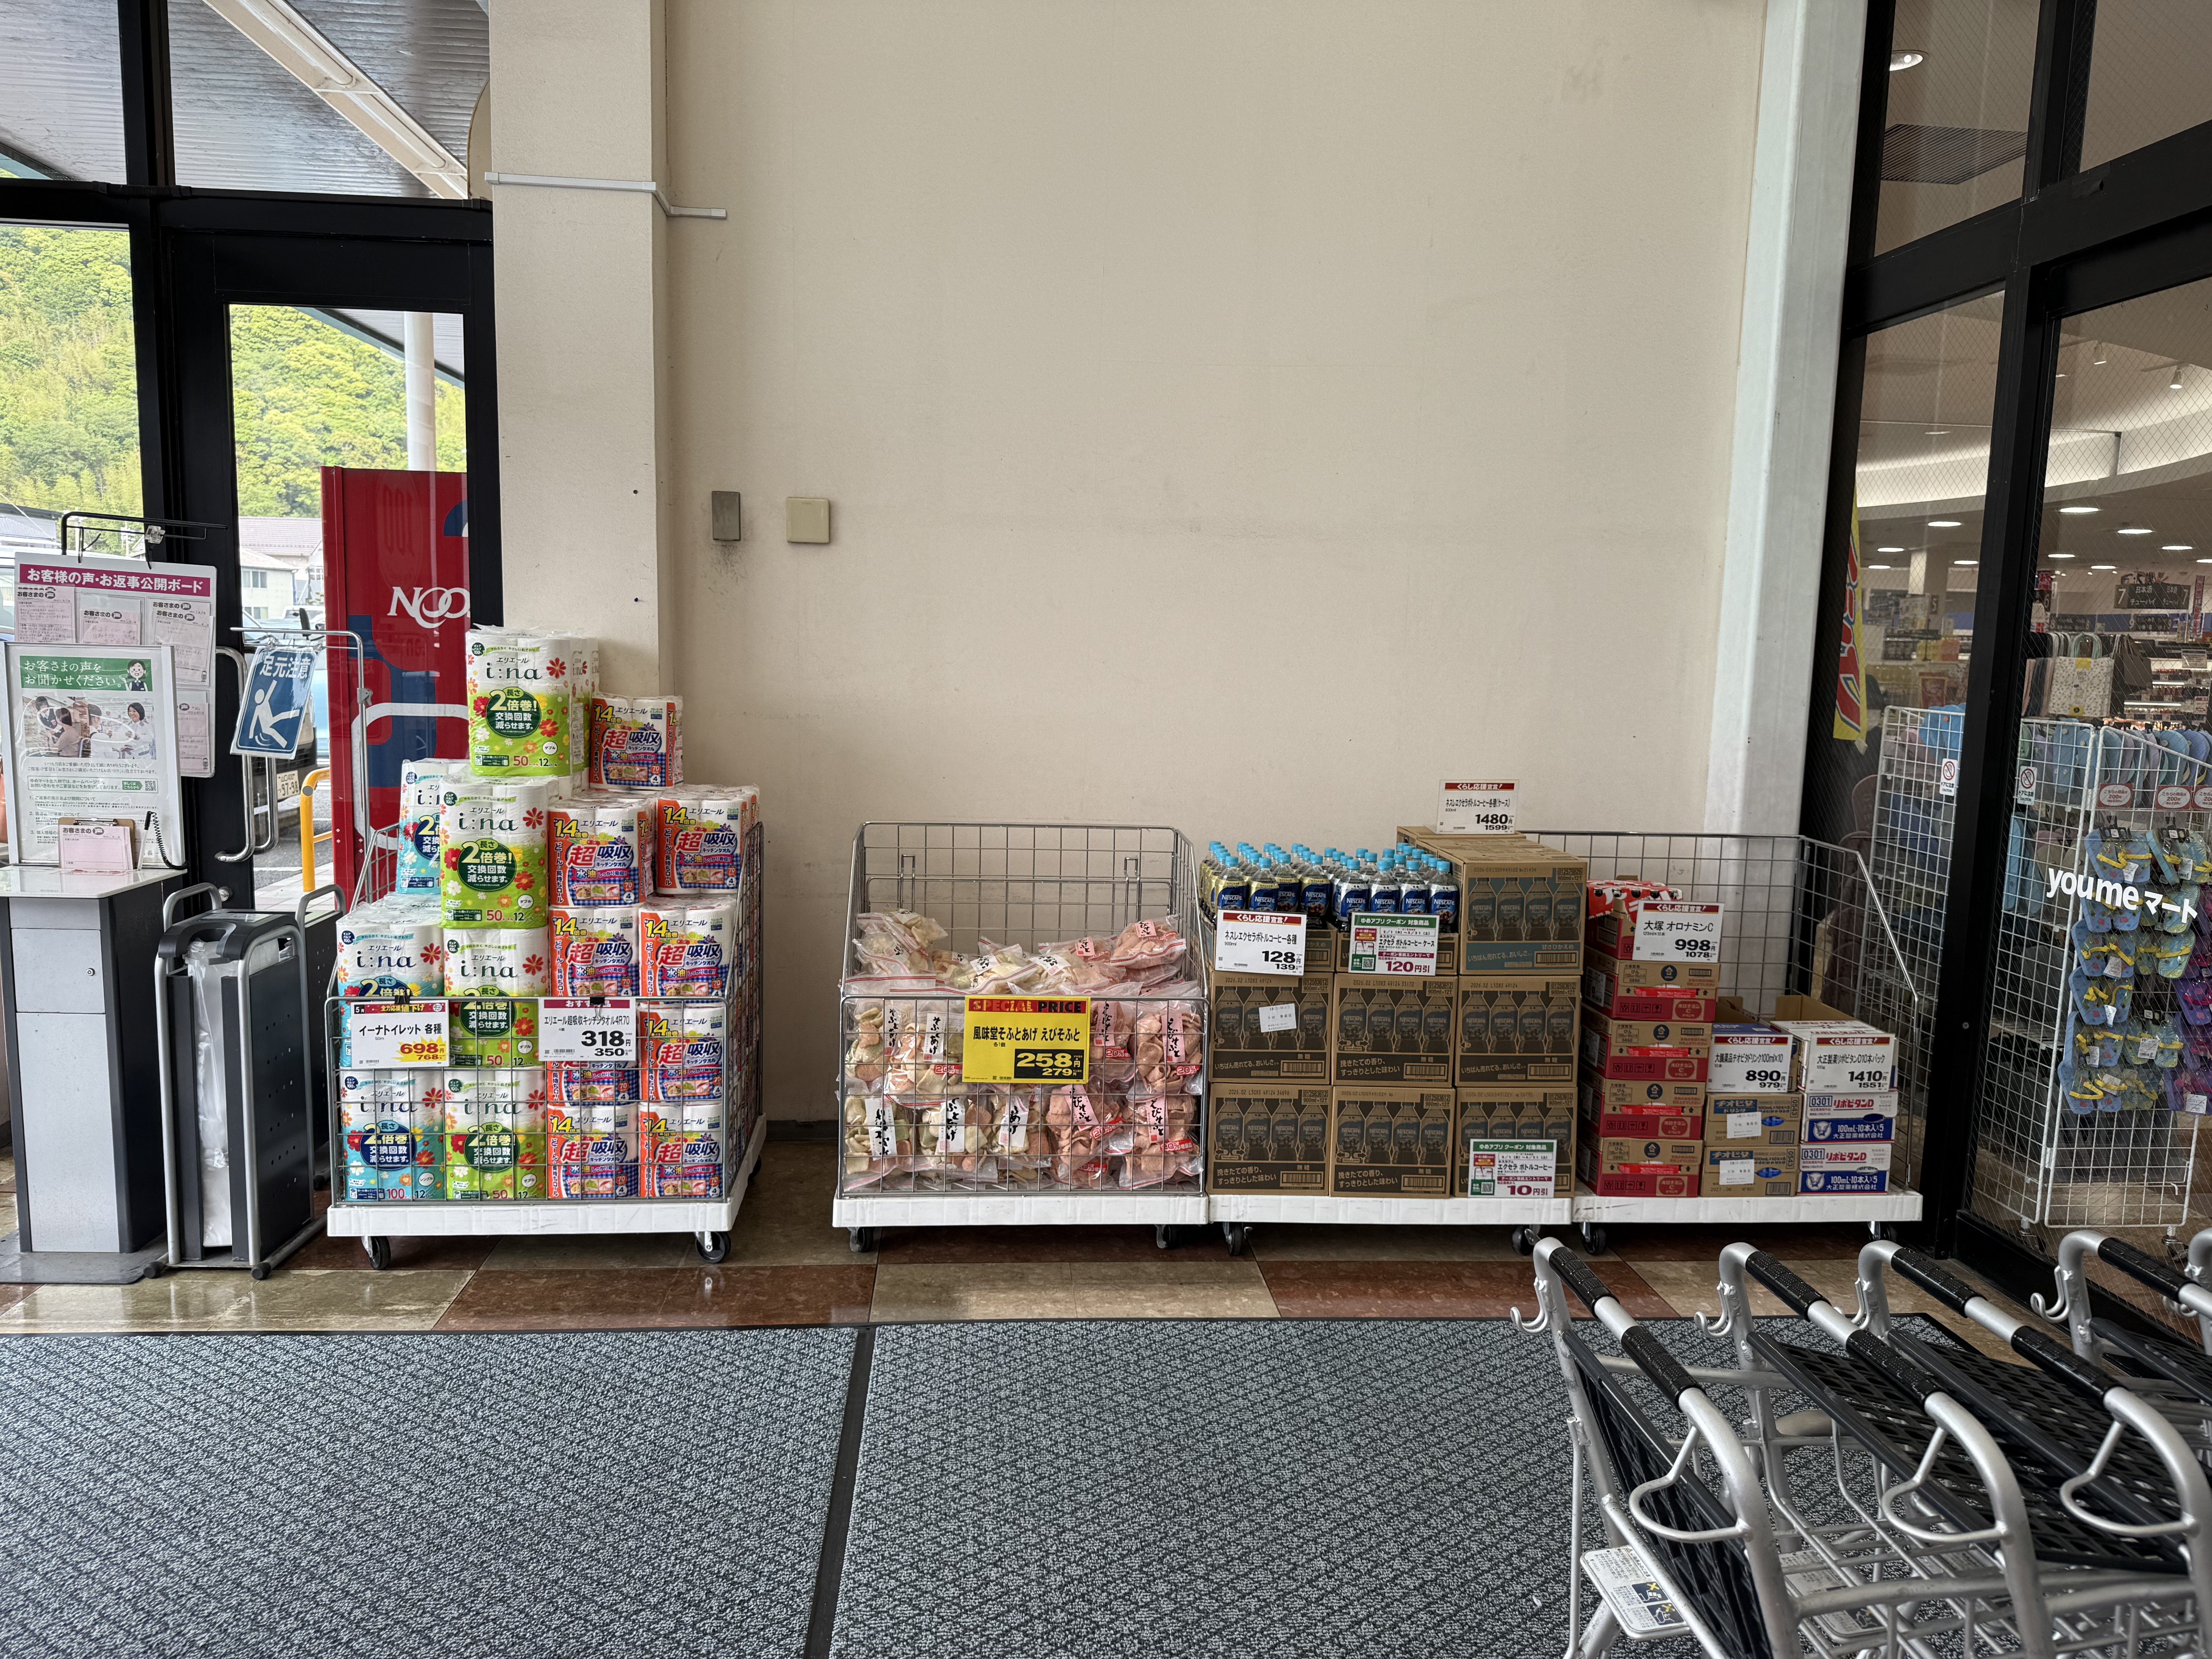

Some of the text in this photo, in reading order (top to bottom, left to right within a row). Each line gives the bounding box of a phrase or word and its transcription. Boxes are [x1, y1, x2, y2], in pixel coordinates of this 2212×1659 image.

[27, 568, 203, 594] お客様の声・お返事公開ボード
[2118, 588, 2126, 604] 7
[387, 586, 471, 629] NOO
[24, 660, 101, 673] お客さまの声を
[259, 655, 311, 679] 足元注意
[25, 674, 122, 688] お聞かせください。
[616, 706, 648, 715] エリエール
[495, 721, 534, 731] 減らせます。
[480, 841, 495, 849] 長さ
[467, 865, 507, 874] 交換回数
[467, 874, 508, 883] 減らせます。
[1643, 920, 1714, 933] 大塚 オロナミンC
[1224, 930, 1297, 945] ネスレエクセラボトルコーヒー各種
[1038, 1001, 1082, 1013] PRICE
[359, 1023, 442, 1036] イーナトイレット 各種
[973, 1026, 1080, 1042] 風味堂そふとあげ えびそふと
[1341, 1065, 1400, 1077] すっきりとした味わい
[1811, 1097, 1831, 1106] 0301
[1833, 1098, 1874, 1108] リポビタンD
[1803, 1149, 1823, 1158] 0301
[1826, 1151, 1867, 1161] リポビタンD
[1217, 1173, 1277, 1186] すっきりとした味わい
